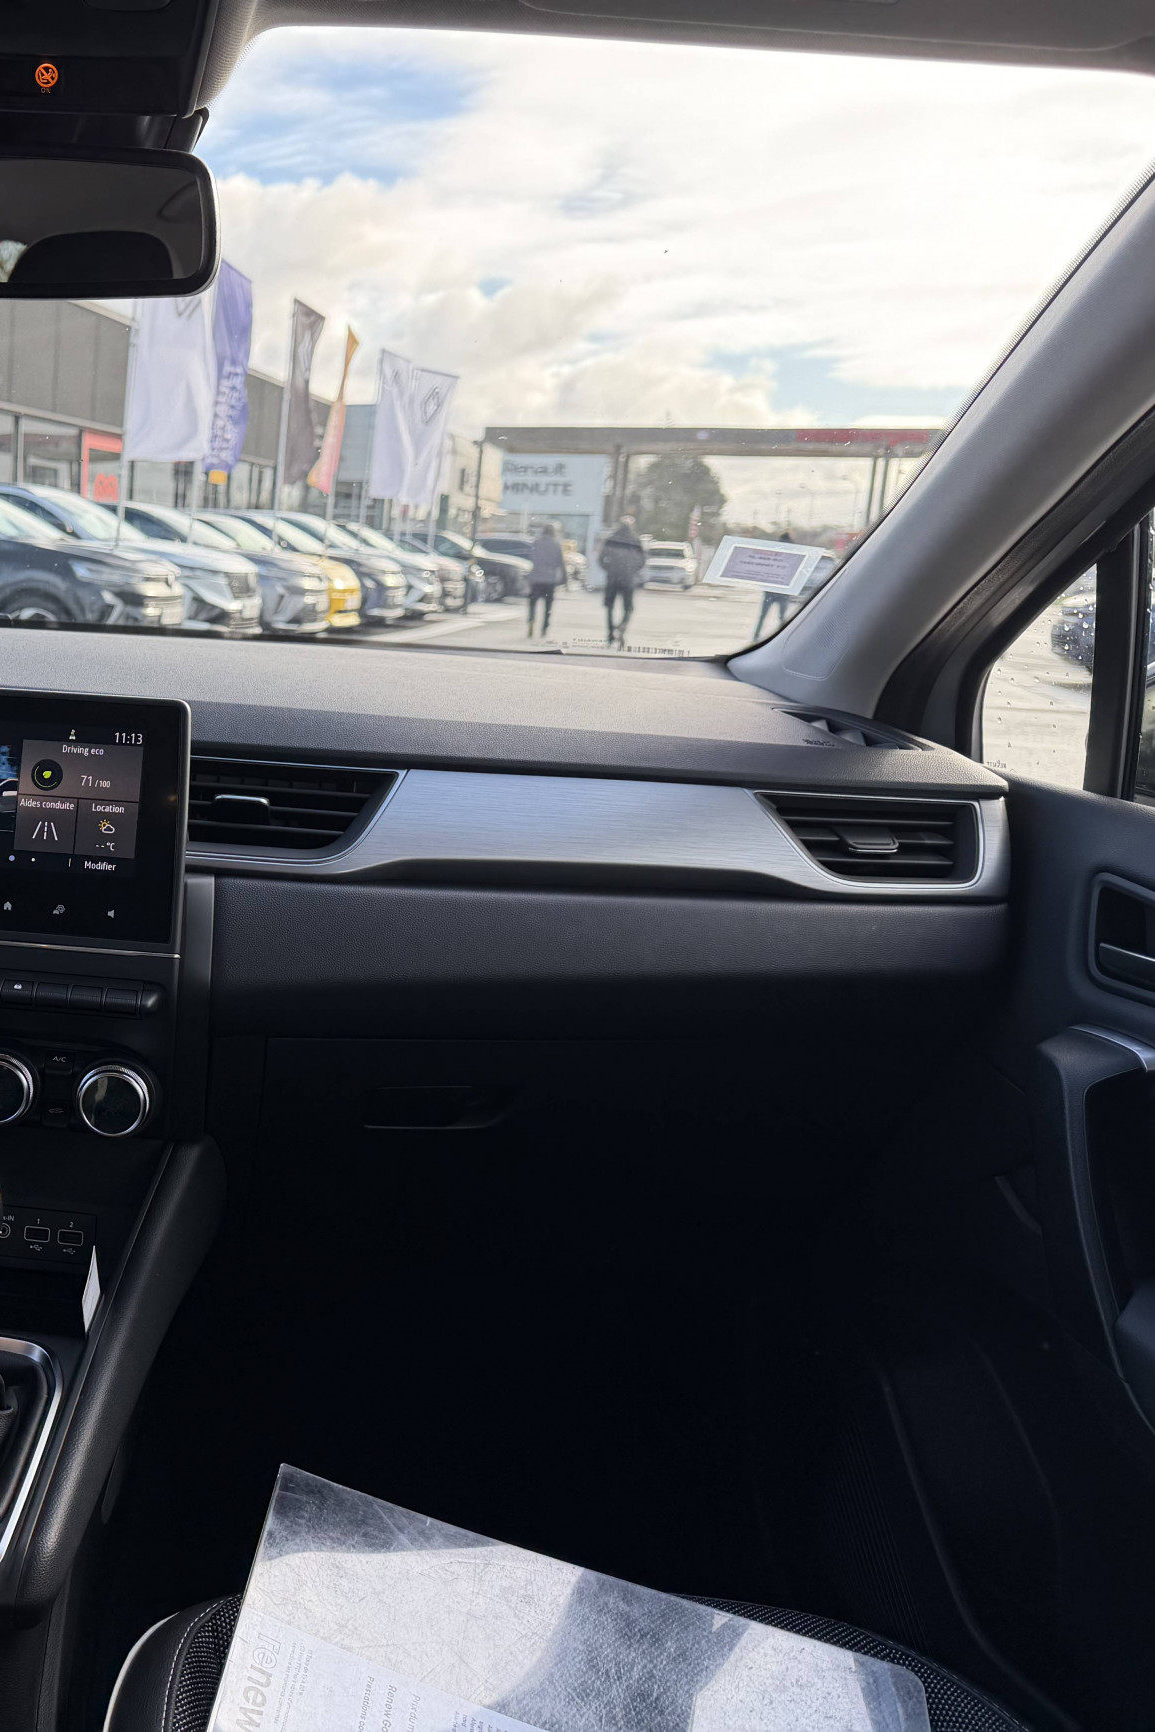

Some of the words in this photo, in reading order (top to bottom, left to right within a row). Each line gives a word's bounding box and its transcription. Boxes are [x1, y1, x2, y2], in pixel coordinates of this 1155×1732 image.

[114, 732, 143, 745] 11:13
[62, 744, 89, 756] Driving
[80, 775, 92, 787] 71
[20, 798, 41, 808] Aides
[42, 800, 75, 810] conduite
[92, 803, 124, 813] Location
[85, 861, 116, 871] Modifier
[360, 1676, 374, 1720] Prestations
[384, 1685, 397, 1719] Renew
[411, 1694, 420, 1712] Prix
[409, 1712, 417, 1724] du
